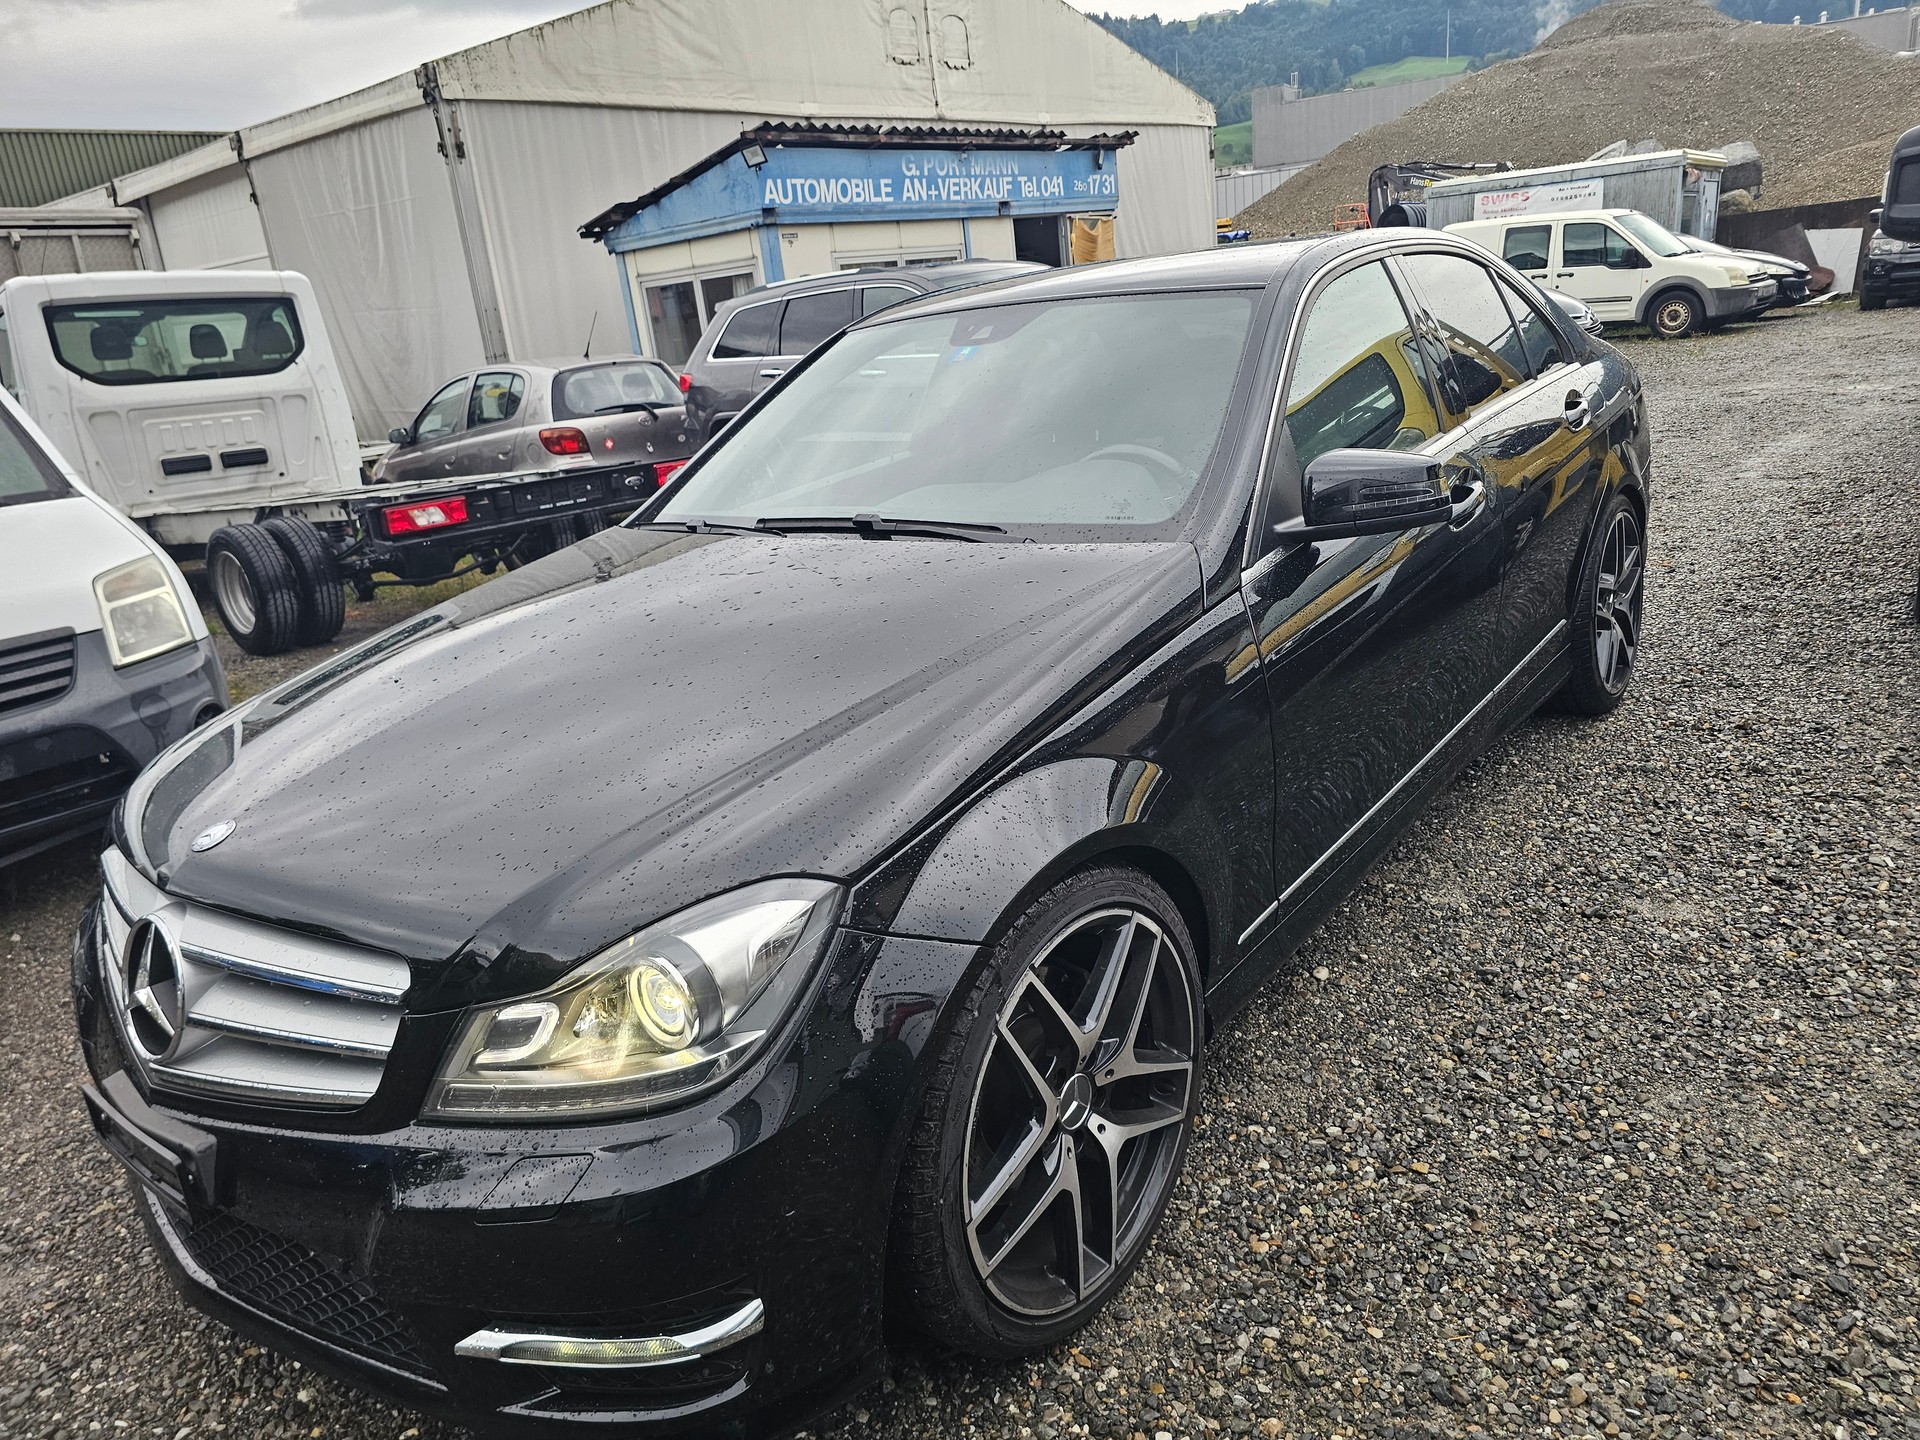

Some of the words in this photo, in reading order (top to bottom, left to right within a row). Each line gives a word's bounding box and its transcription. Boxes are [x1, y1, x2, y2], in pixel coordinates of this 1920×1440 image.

[901, 155, 920, 176] G.
[764, 178, 894, 205] AUTOMOBILE
[902, 176, 1013, 202] AN+VERKAUF
[1480, 190, 1531, 207] SWISS
